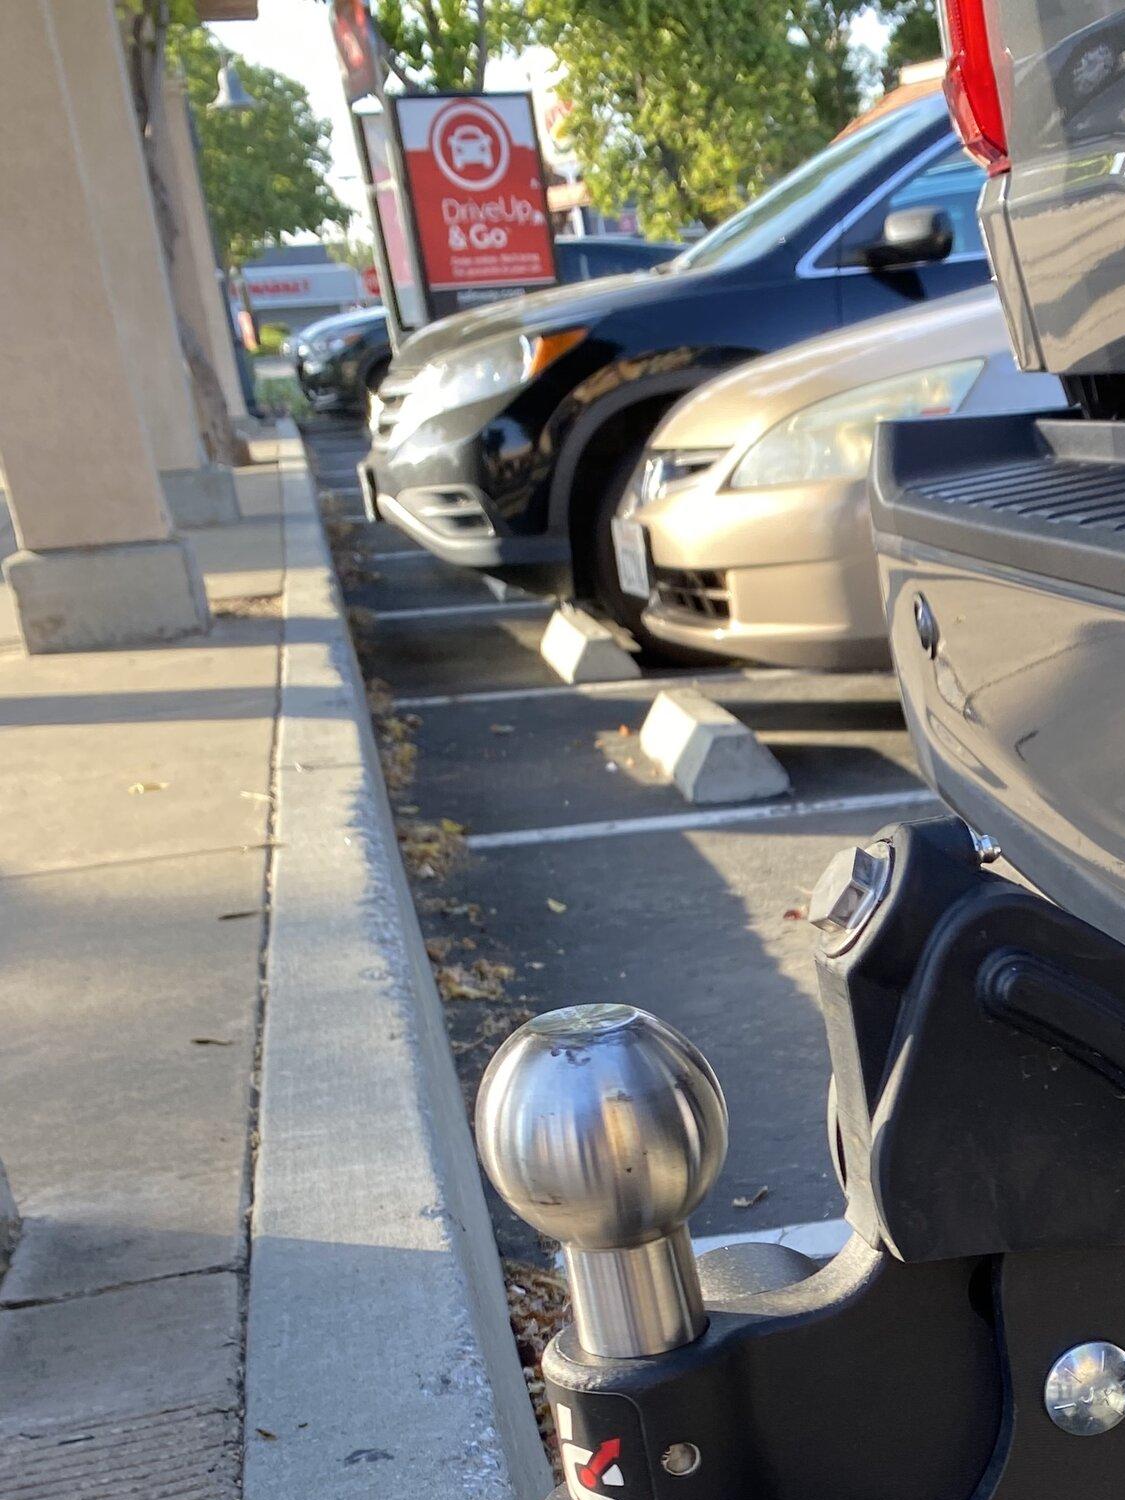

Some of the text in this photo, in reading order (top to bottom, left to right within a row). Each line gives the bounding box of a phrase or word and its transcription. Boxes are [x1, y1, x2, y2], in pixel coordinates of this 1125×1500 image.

[442, 195, 533, 224] DriveUp
[449, 223, 508, 250] & Go
